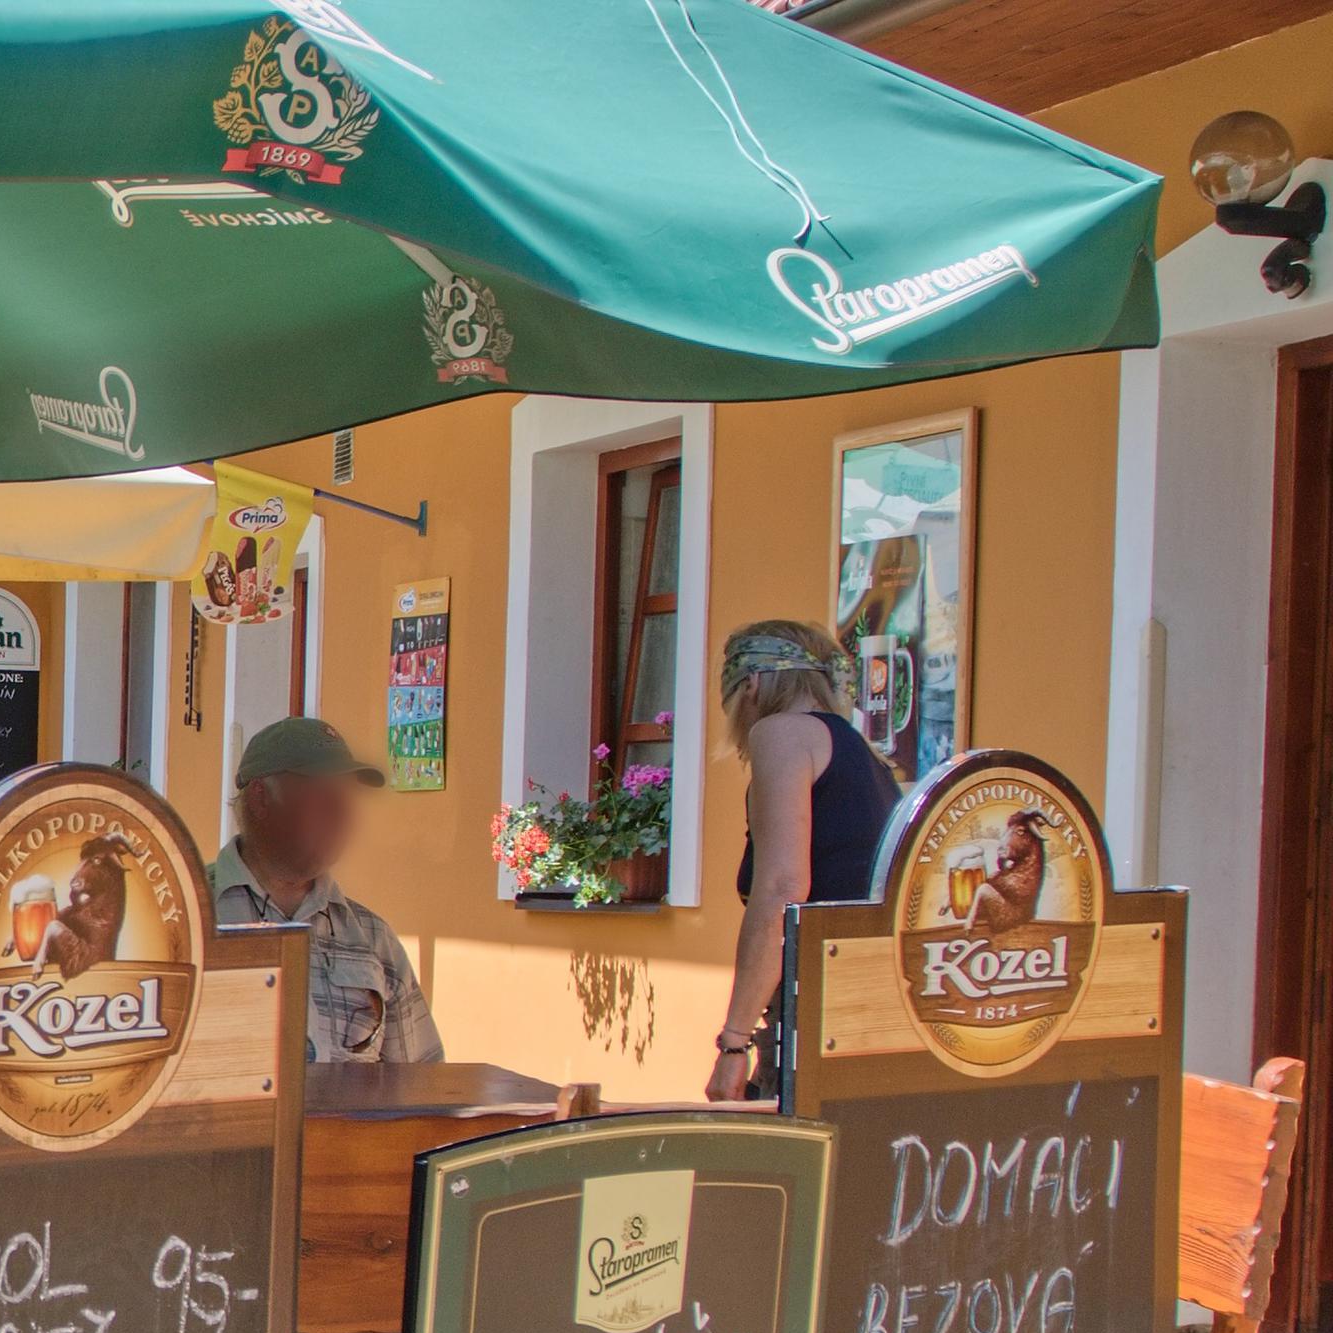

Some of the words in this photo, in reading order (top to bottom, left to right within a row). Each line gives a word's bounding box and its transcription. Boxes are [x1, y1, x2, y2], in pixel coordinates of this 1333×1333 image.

[259, 141, 313, 170] 1869
[766, 241, 1039, 355] Staropramen
[241, 512, 279, 524] Prima
[919, 935, 1069, 999] Kozel
[974, 1003, 1018, 1021] 1874
[588, 1237, 680, 1297] Staropramen
